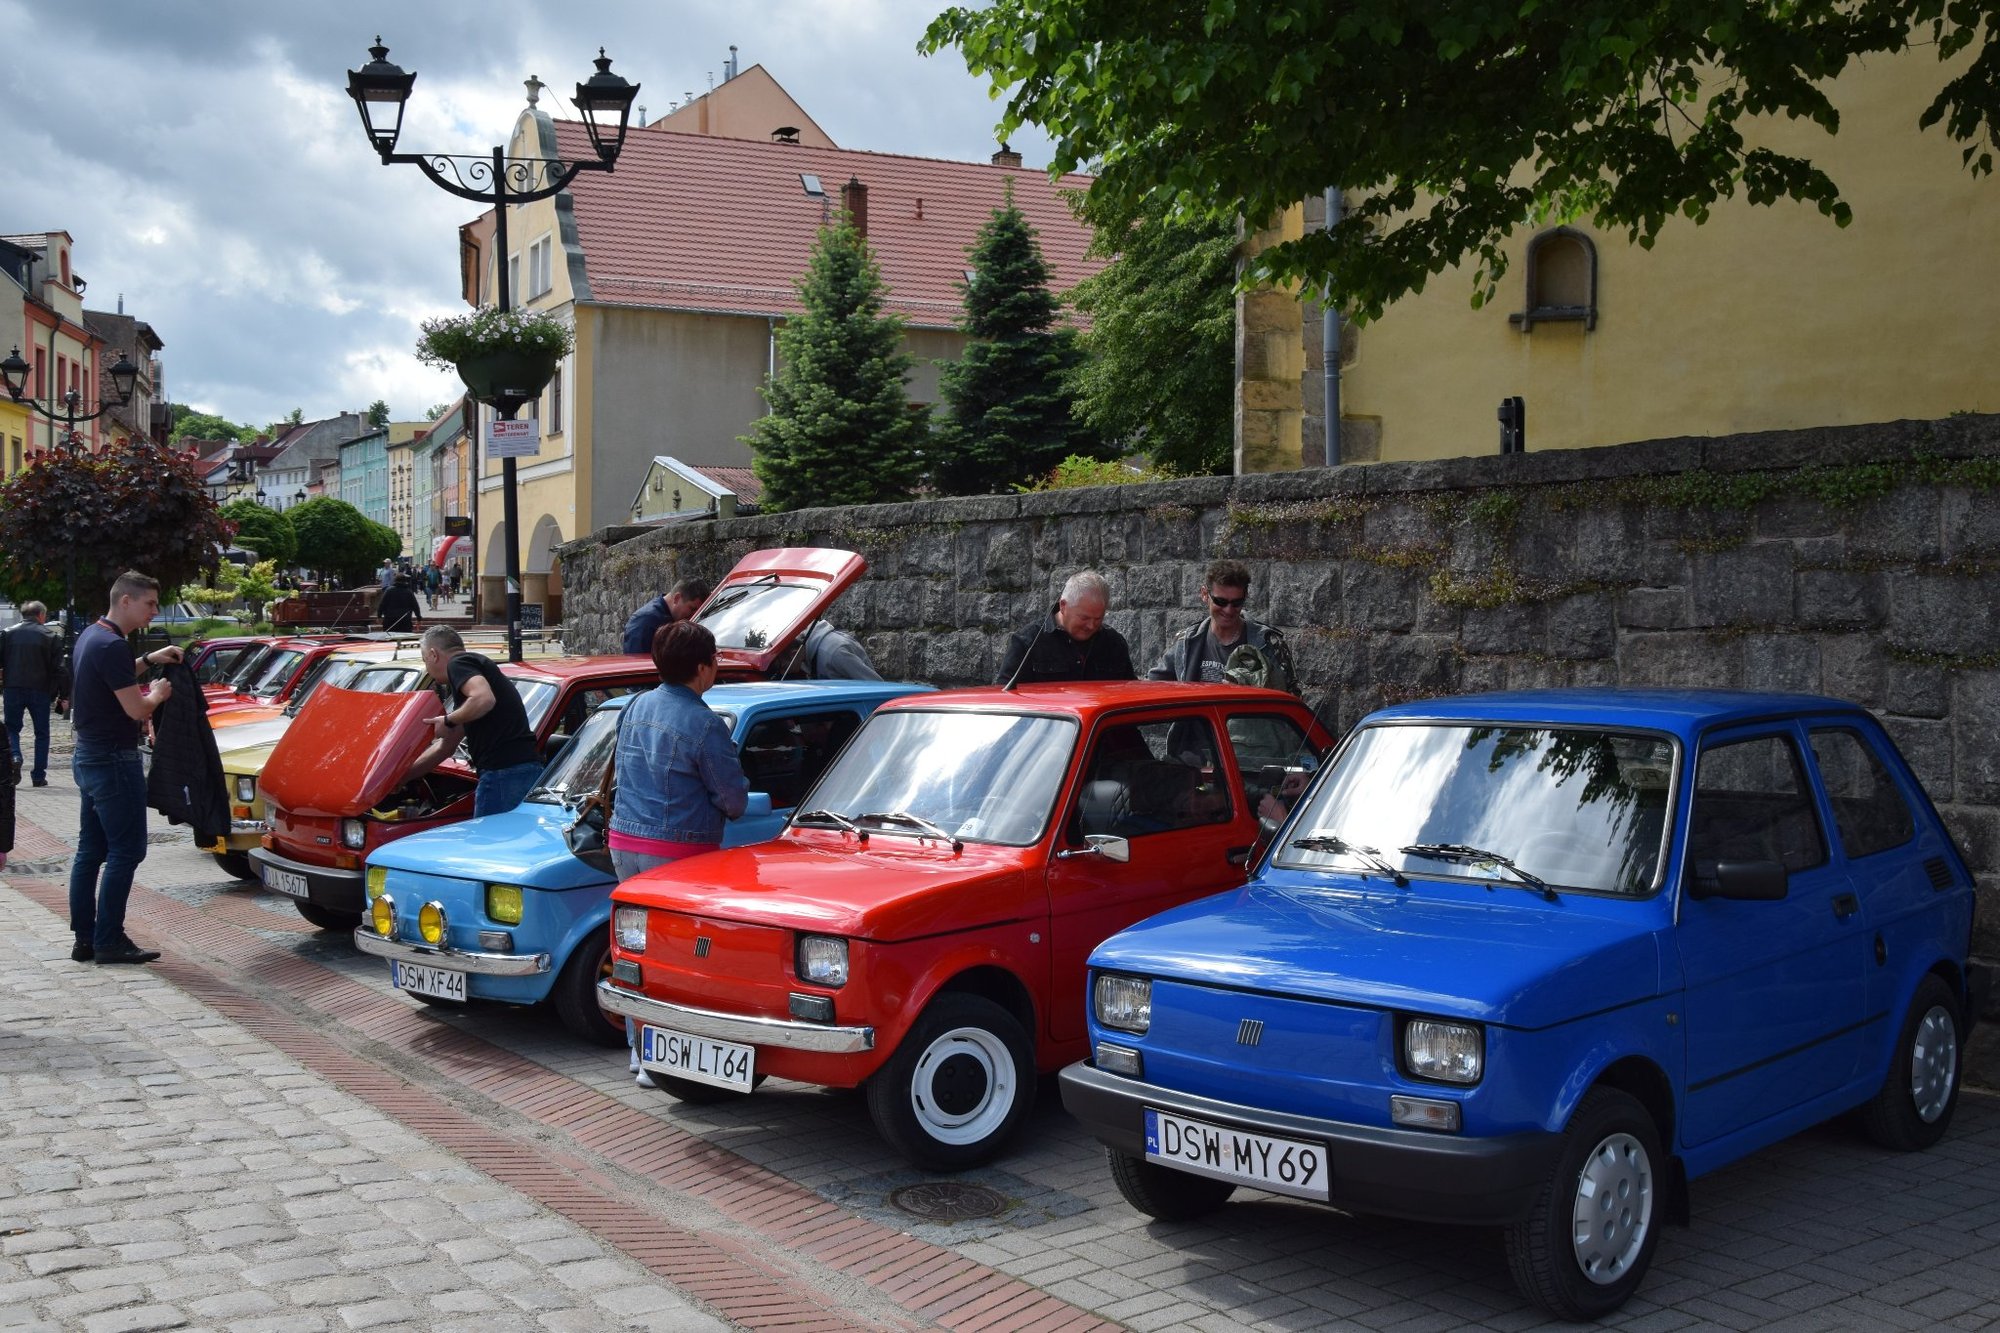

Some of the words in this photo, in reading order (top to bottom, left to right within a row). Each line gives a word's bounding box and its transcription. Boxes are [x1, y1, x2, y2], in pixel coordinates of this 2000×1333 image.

[281, 872, 306, 895] 15677
[399, 964, 424, 991] DSW
[430, 970, 463, 998] XF44
[645, 1048, 652, 1057] PL
[656, 1033, 692, 1068] DSW
[698, 1042, 749, 1081] LT64
[1147, 1136, 1157, 1148] PL
[1164, 1118, 1220, 1167] DSW
[1233, 1135, 1318, 1185] MY69
